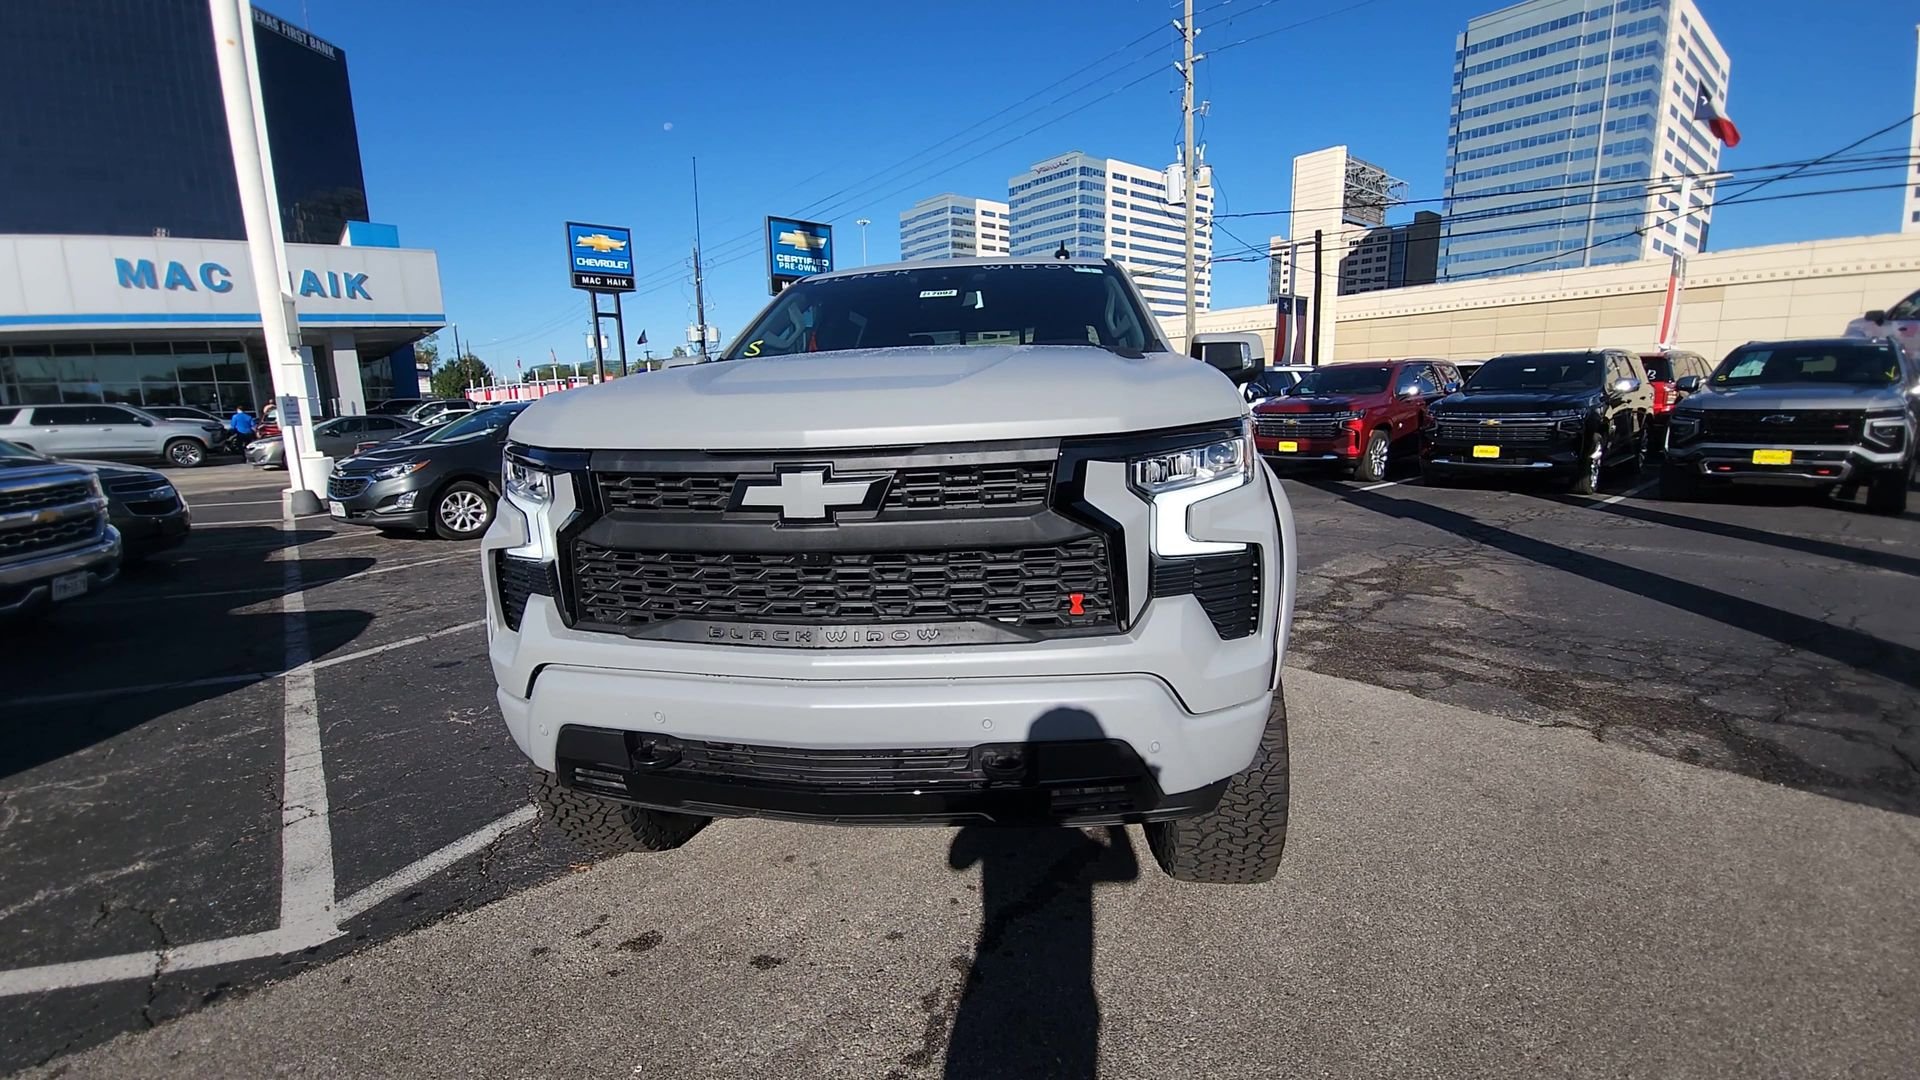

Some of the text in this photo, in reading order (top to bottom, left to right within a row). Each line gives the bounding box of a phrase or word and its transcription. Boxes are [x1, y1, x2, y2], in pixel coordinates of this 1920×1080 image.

[281, 22, 307, 44] FIRST
[309, 36, 336, 58] BANK
[576, 257, 629, 269] CHEVROLET
[776, 254, 829, 267] CERTIFIED
[779, 262, 828, 273] PRE-OWNED
[115, 258, 373, 300] MAC AIK
[582, 276, 628, 287] MAC HAIK
[708, 625, 941, 643] BLACK WIDOW
